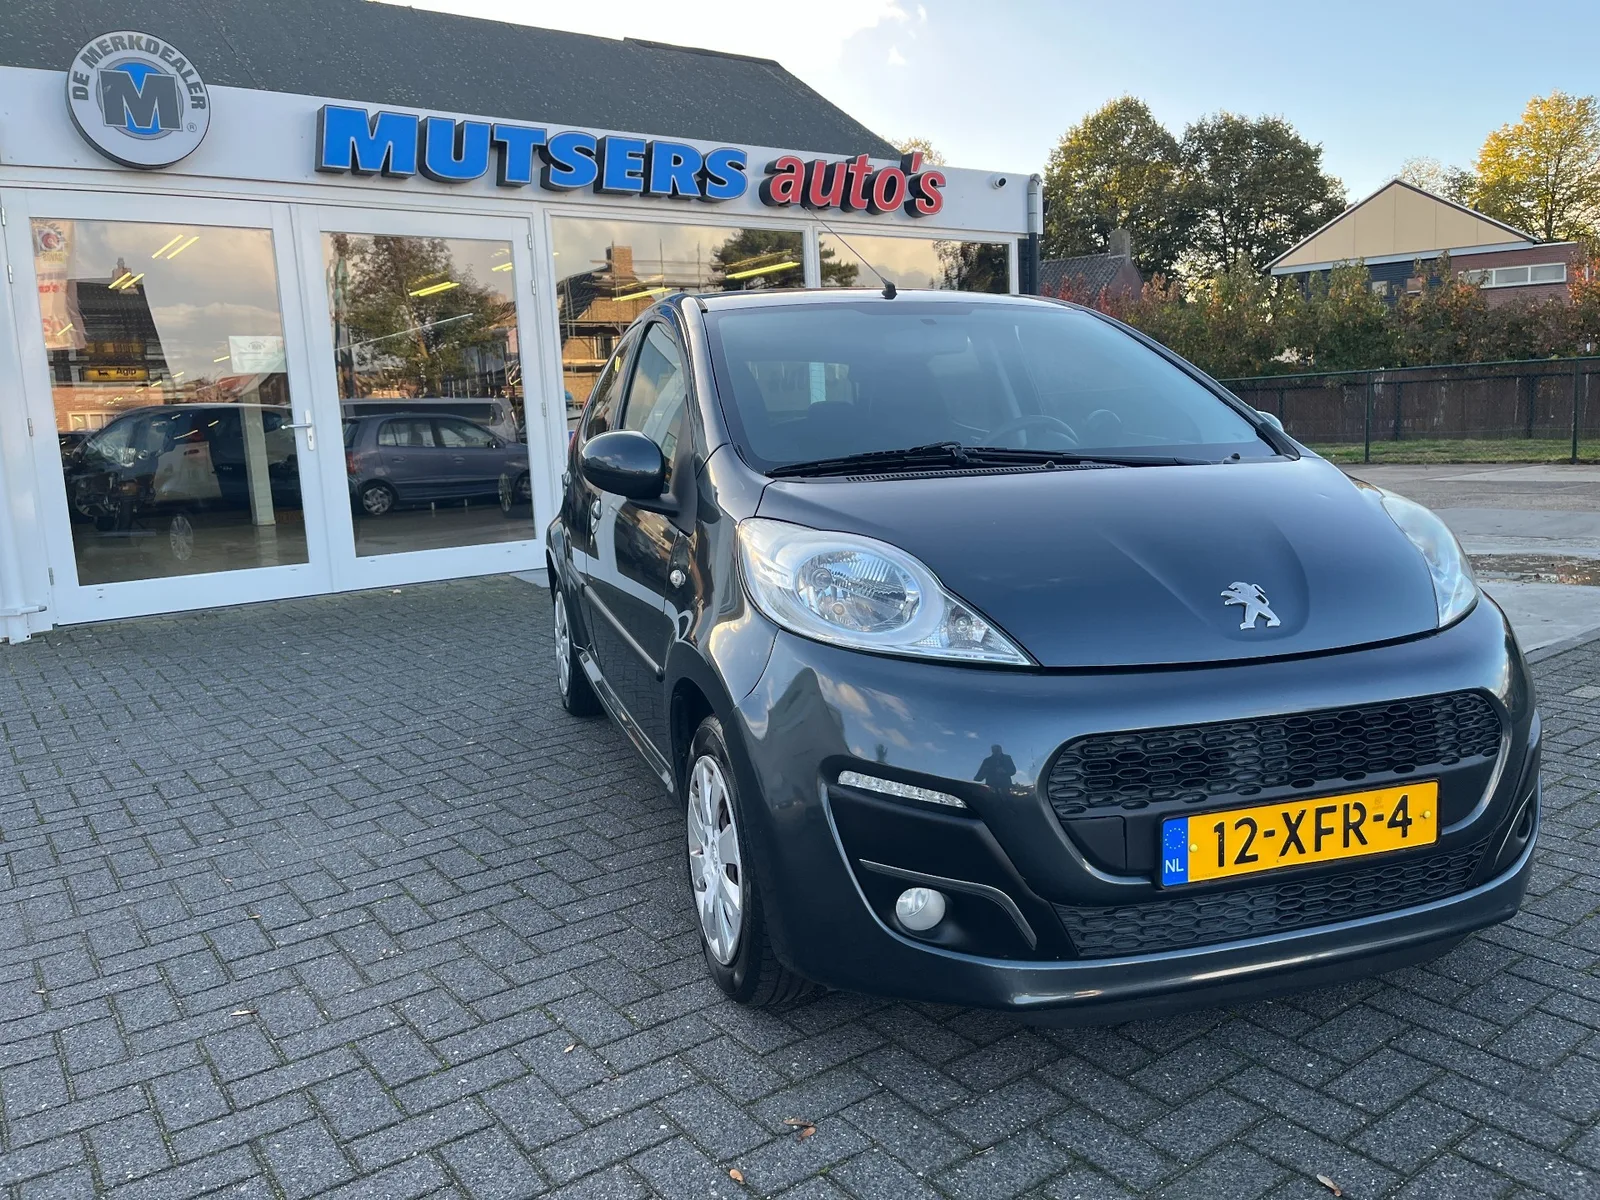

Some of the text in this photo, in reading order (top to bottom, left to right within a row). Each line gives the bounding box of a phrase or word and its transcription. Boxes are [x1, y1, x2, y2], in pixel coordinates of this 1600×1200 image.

[72, 34, 207, 110] DE MERKDEALER
[97, 67, 183, 132] M
[319, 104, 946, 217] MUTSERS auto's
[1164, 859, 1185, 874] NL
[1213, 794, 1413, 868] 12-XFR-4
